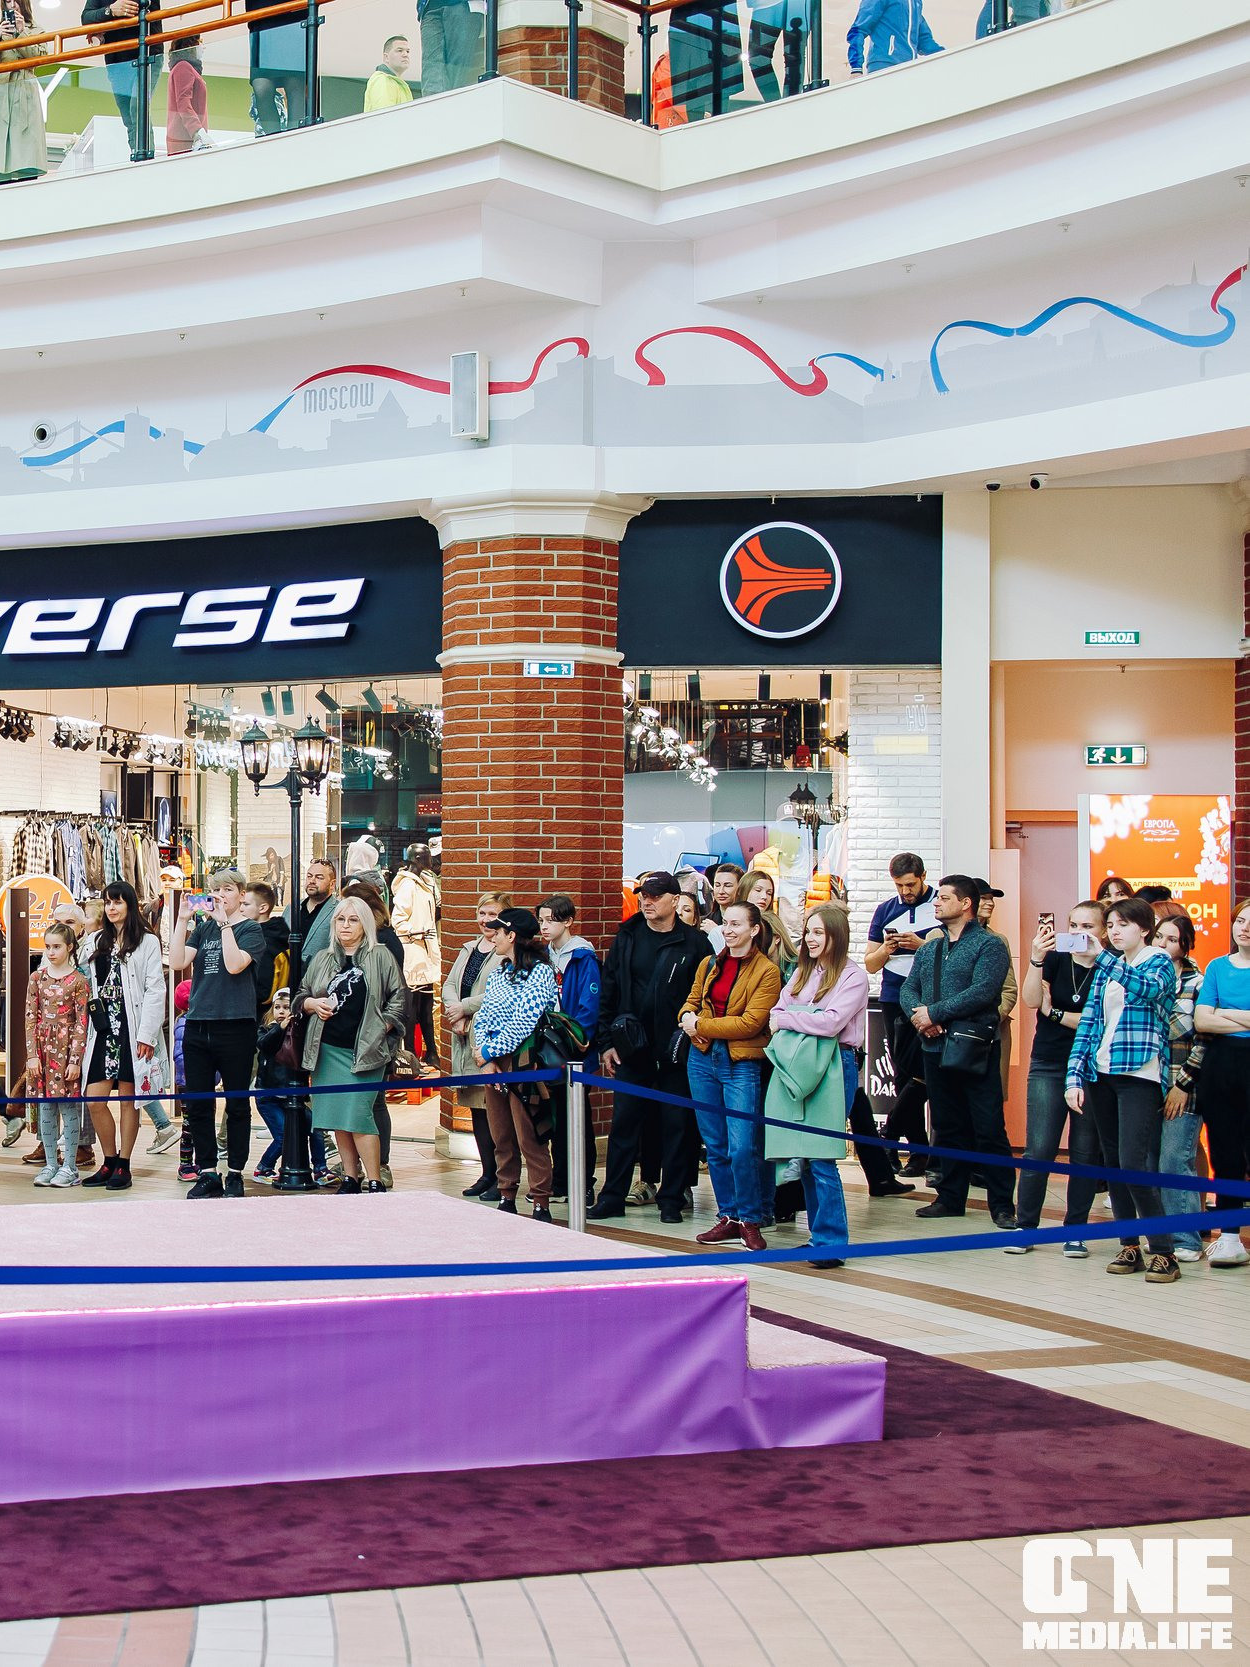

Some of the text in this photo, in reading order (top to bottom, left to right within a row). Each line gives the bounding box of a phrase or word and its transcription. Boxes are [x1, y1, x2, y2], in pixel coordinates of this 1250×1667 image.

[303, 382, 374, 413] MOSCOW
[1089, 631, 1136, 645] ВЫХОД
[1143, 819, 1175, 829] ЕВРОПА
